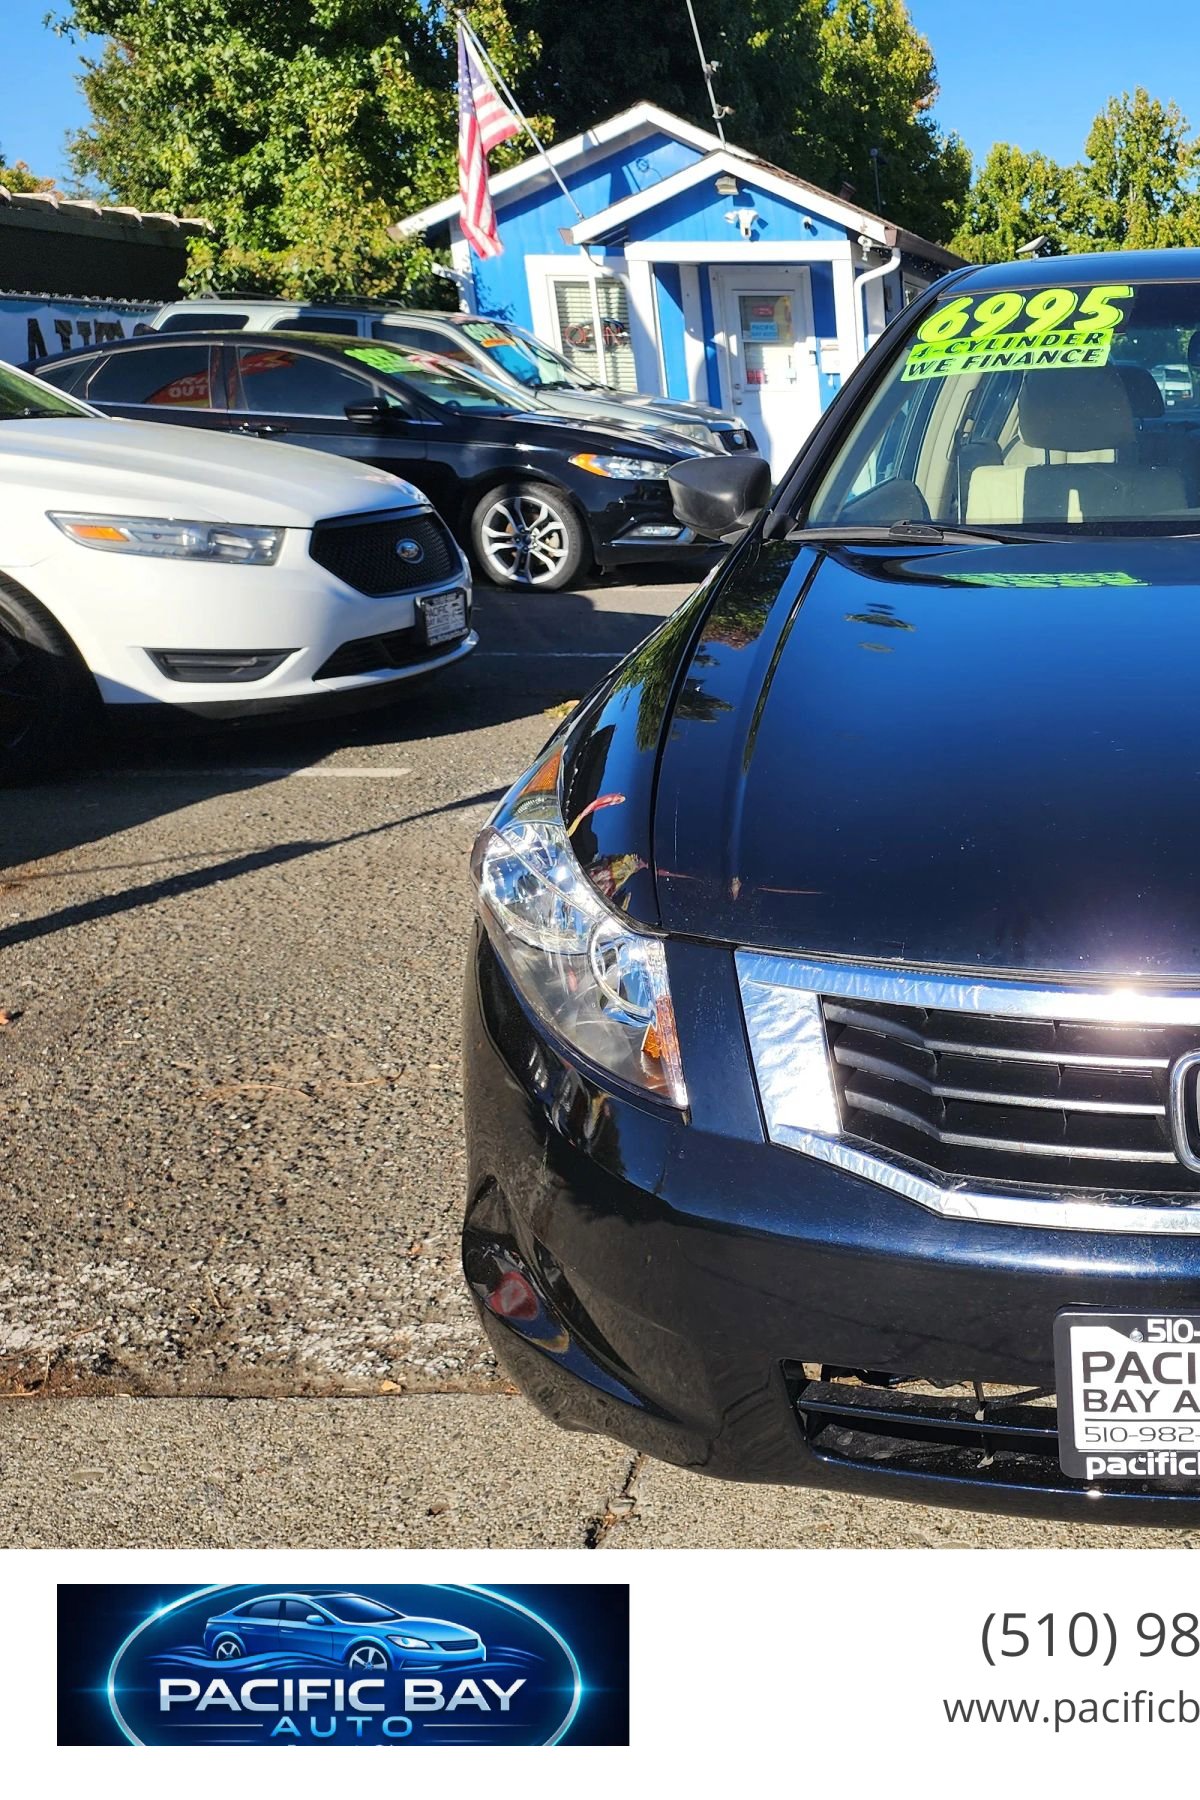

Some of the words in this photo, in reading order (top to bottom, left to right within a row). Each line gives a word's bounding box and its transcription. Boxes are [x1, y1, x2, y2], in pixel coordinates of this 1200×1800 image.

[917, 284, 1135, 343] 6995
[912, 331, 1105, 360] 4-CYLINDER
[906, 358, 953, 377] WE
[961, 348, 1104, 371] FINANCE
[1083, 1389, 1161, 1414] BAY
